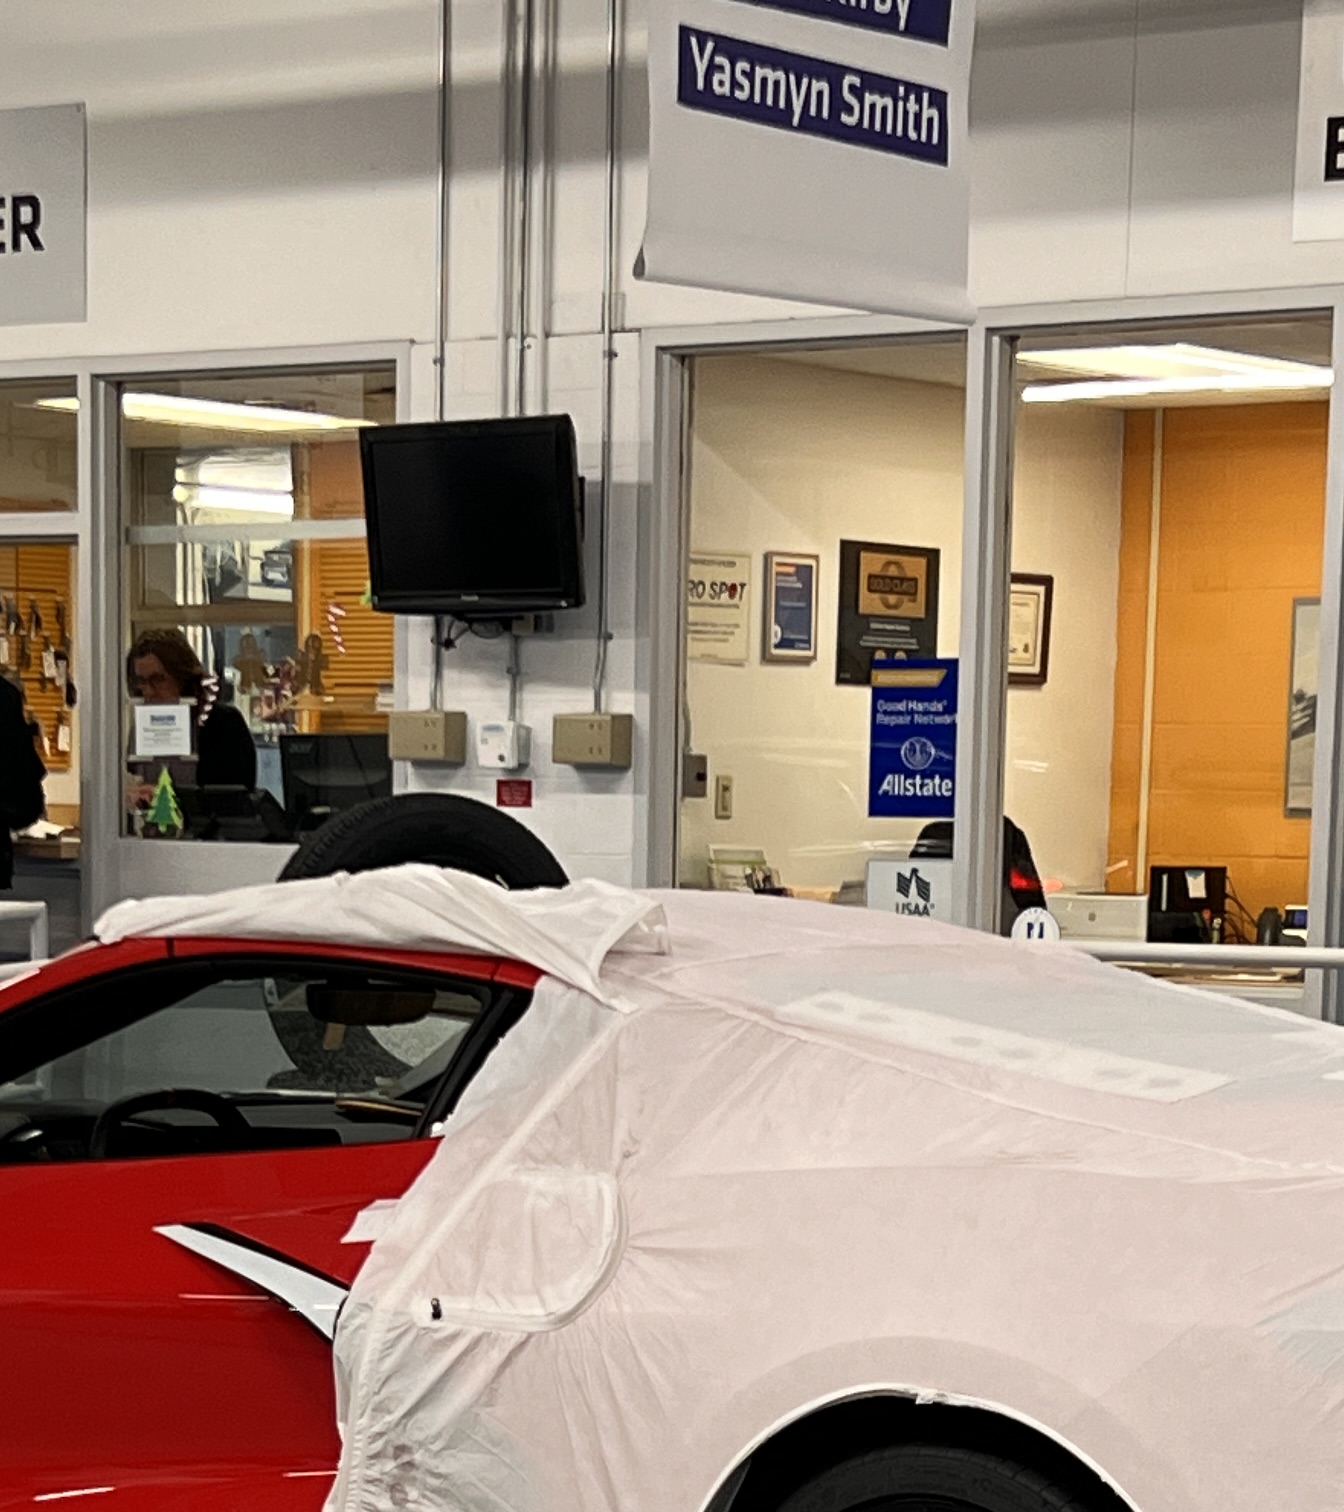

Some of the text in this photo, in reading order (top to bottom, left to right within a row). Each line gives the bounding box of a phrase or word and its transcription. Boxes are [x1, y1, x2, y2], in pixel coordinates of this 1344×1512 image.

[689, 34, 940, 146] Yasmyn Smith
[914, 713, 957, 726] Networ
[877, 773, 953, 797] Allstate
